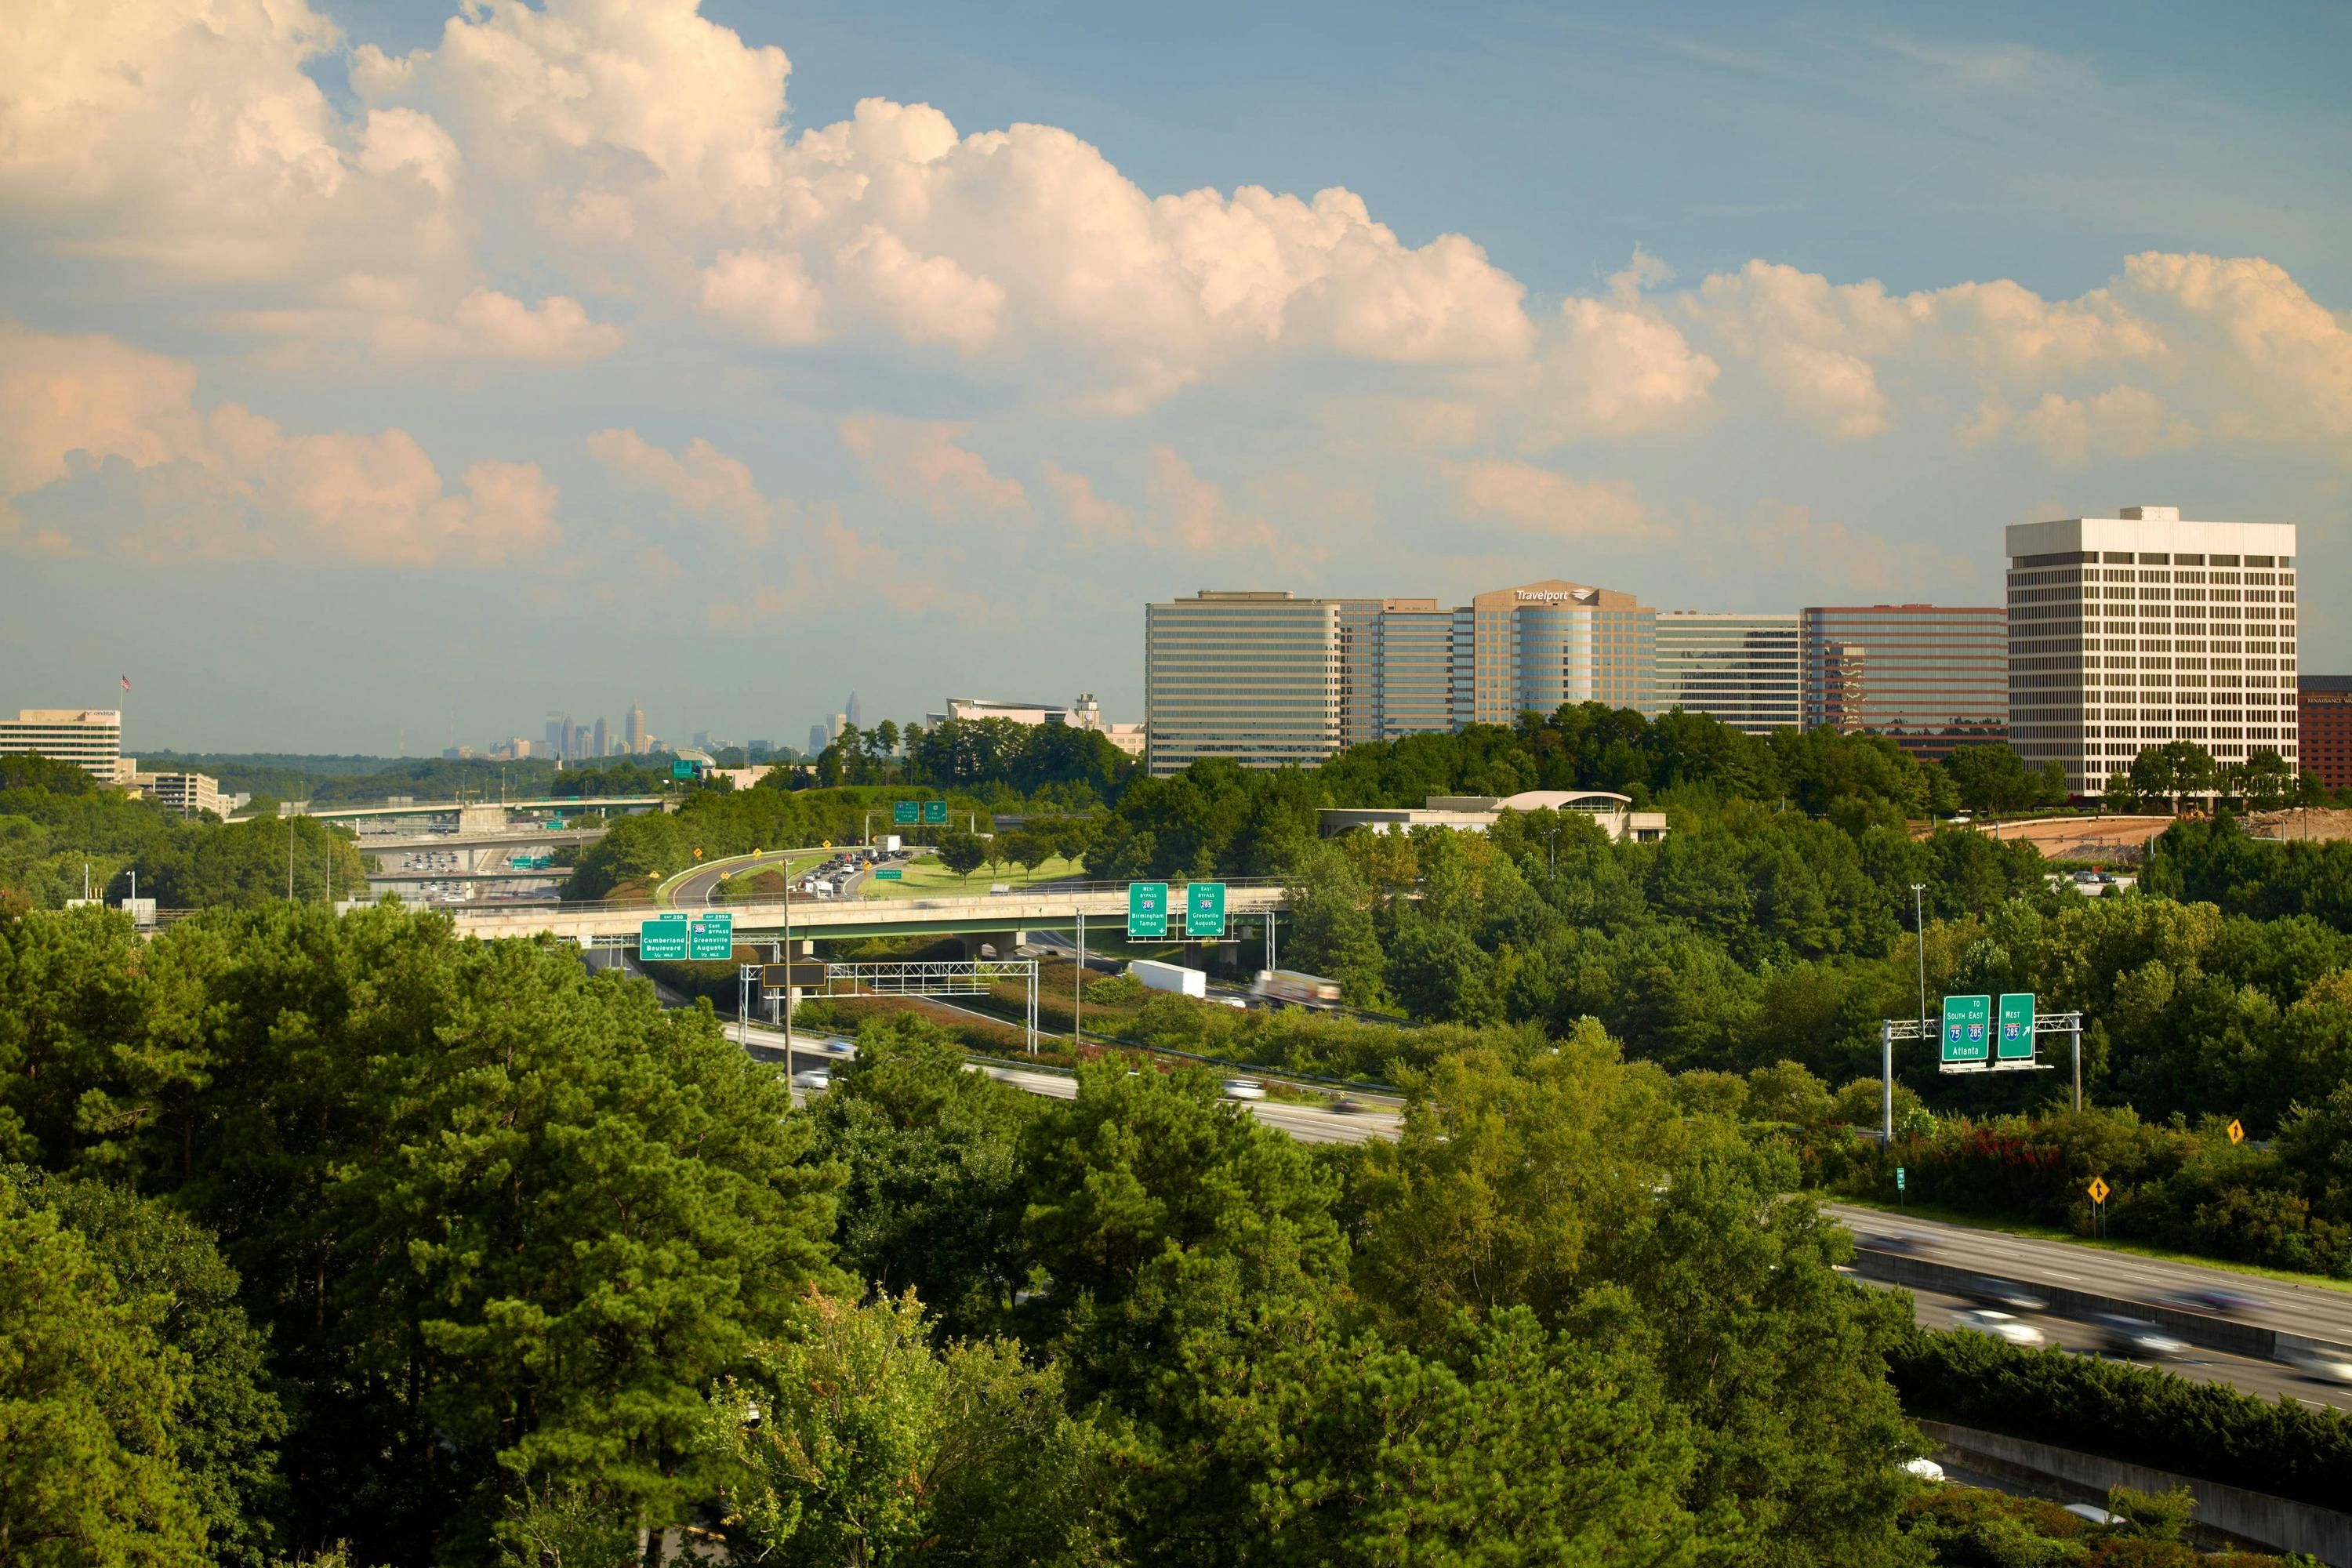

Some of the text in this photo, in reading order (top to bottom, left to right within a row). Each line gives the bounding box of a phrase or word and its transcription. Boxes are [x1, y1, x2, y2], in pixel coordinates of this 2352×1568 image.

[1516, 590, 1568, 602] Travelport
[1969, 1011, 1984, 1019] EAST
[1951, 1029, 1982, 1039] 75 285
[2006, 1028, 2018, 1036] 285
[1952, 1047, 1979, 1056] Atlanta
